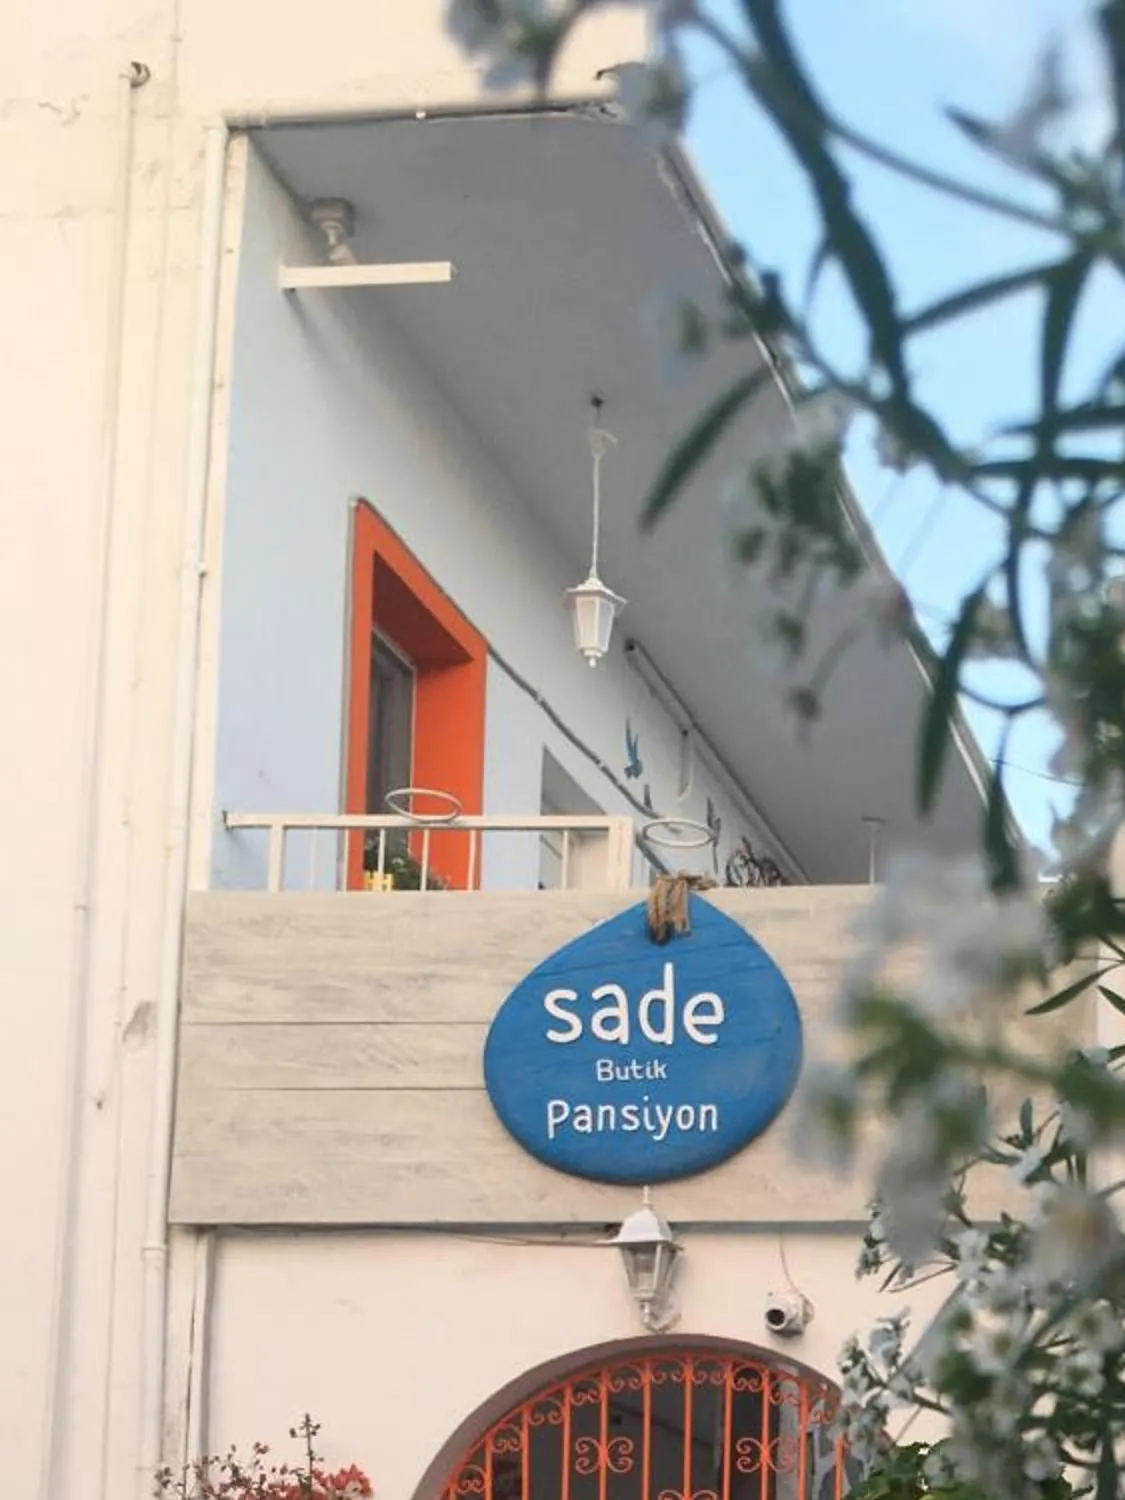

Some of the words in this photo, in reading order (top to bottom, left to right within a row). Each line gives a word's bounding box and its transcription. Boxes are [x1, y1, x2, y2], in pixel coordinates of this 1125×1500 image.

[544, 962, 725, 1045] sade
[596, 1059, 667, 1082] Butik
[546, 1095, 718, 1141] Pansiyon
